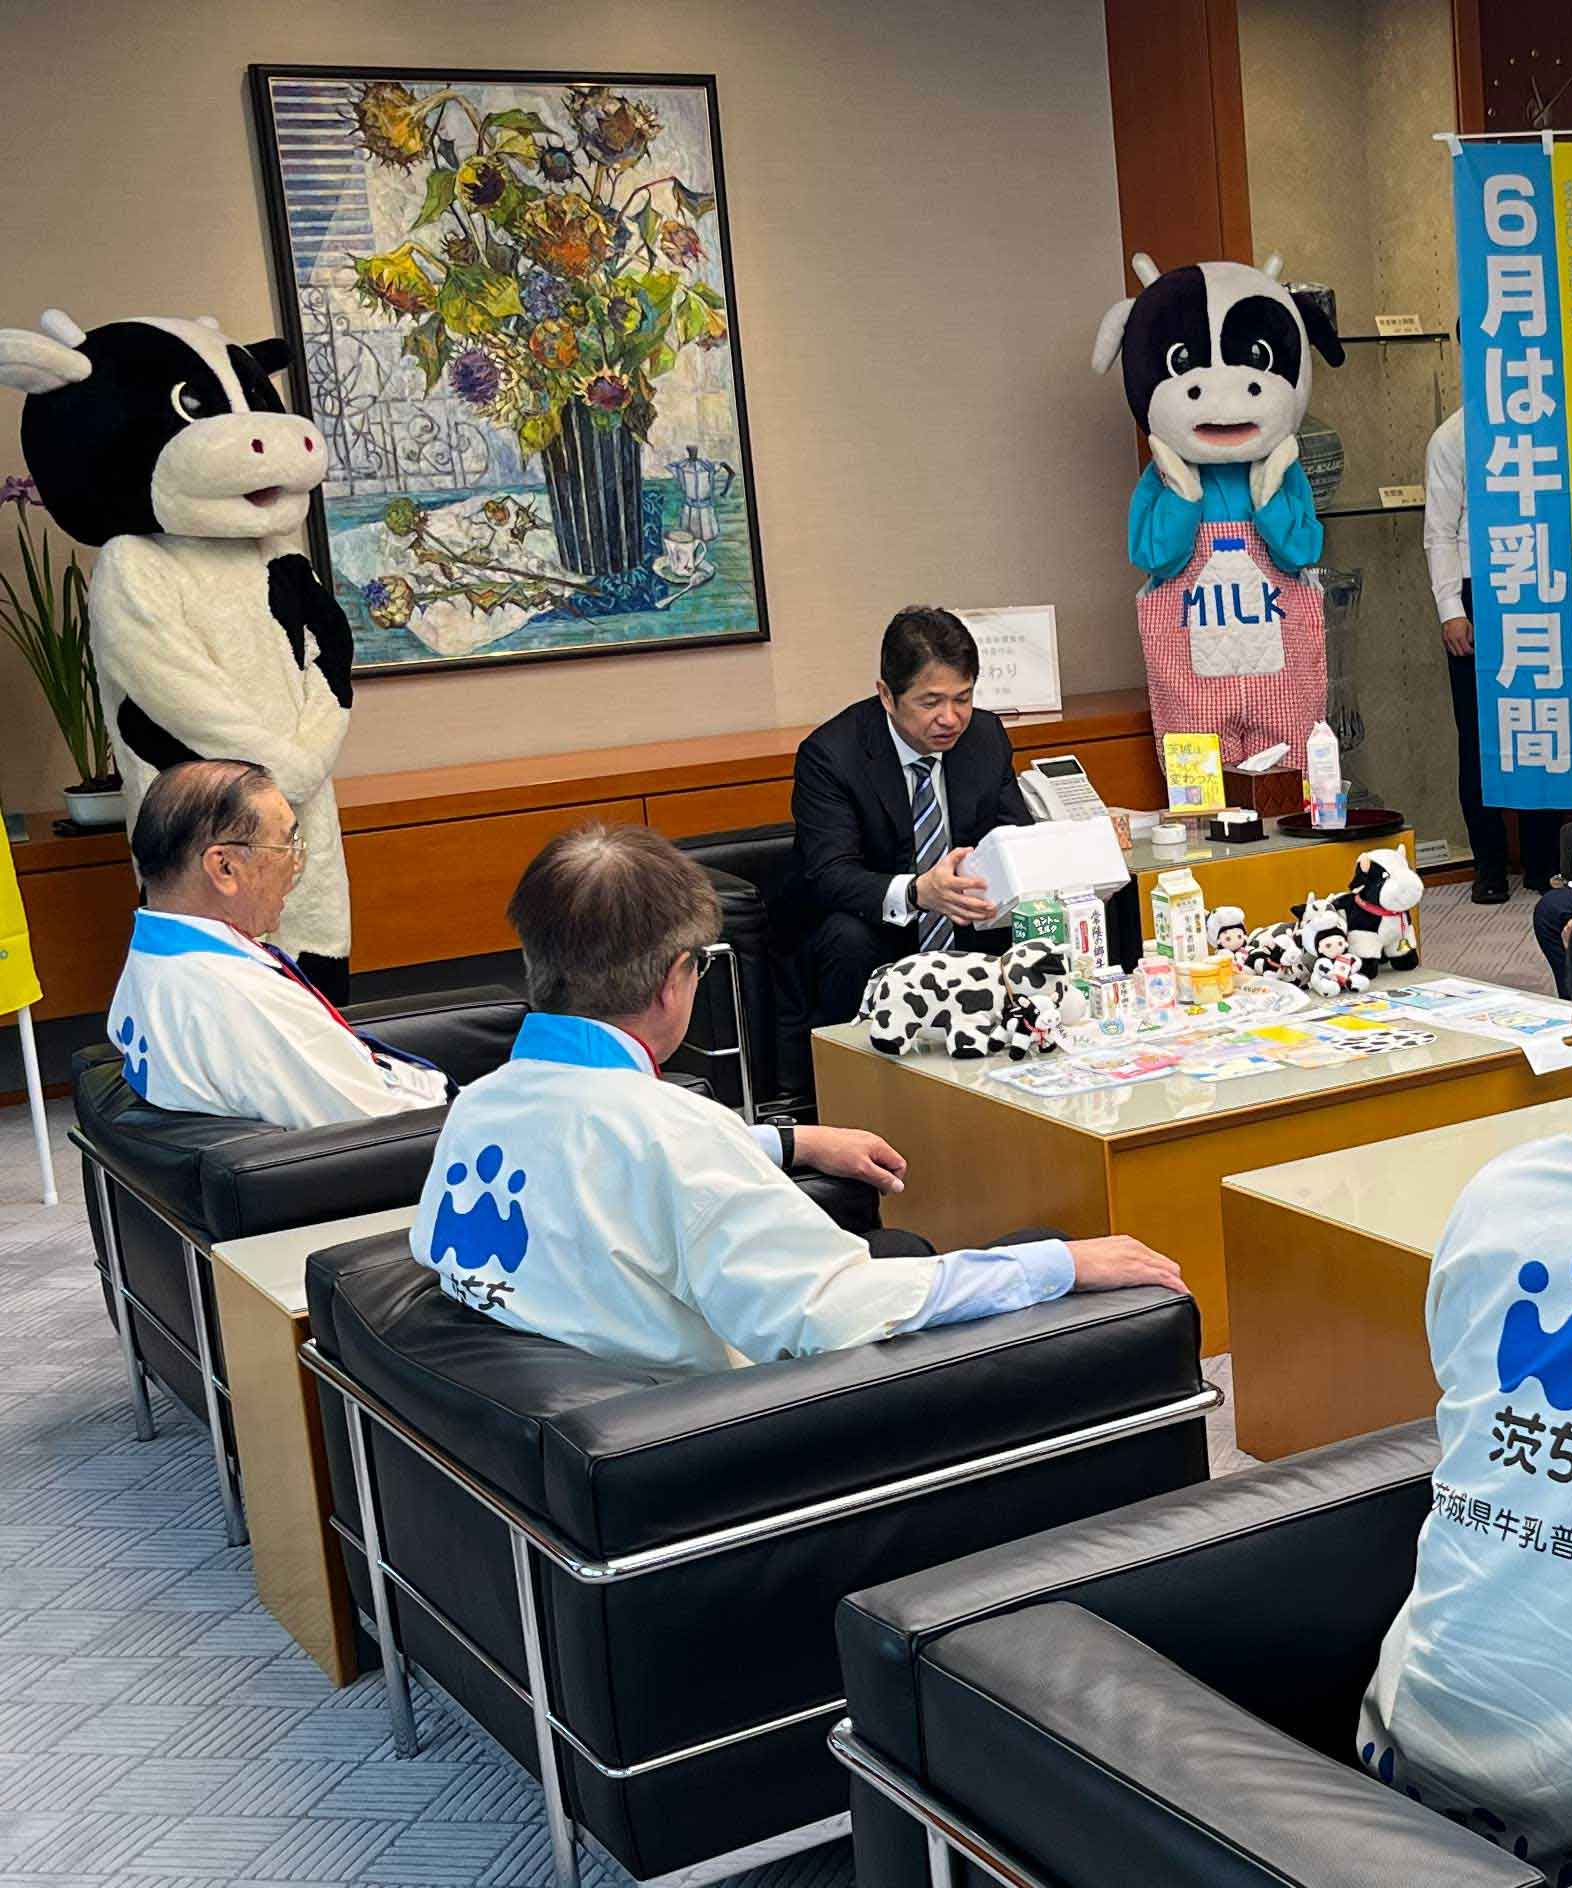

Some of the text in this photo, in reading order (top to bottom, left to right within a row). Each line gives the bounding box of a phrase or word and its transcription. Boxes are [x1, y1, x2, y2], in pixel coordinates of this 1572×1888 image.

[1180, 582, 1287, 628] MILK
[1480, 173, 1572, 774] 6月は牛乳月間
